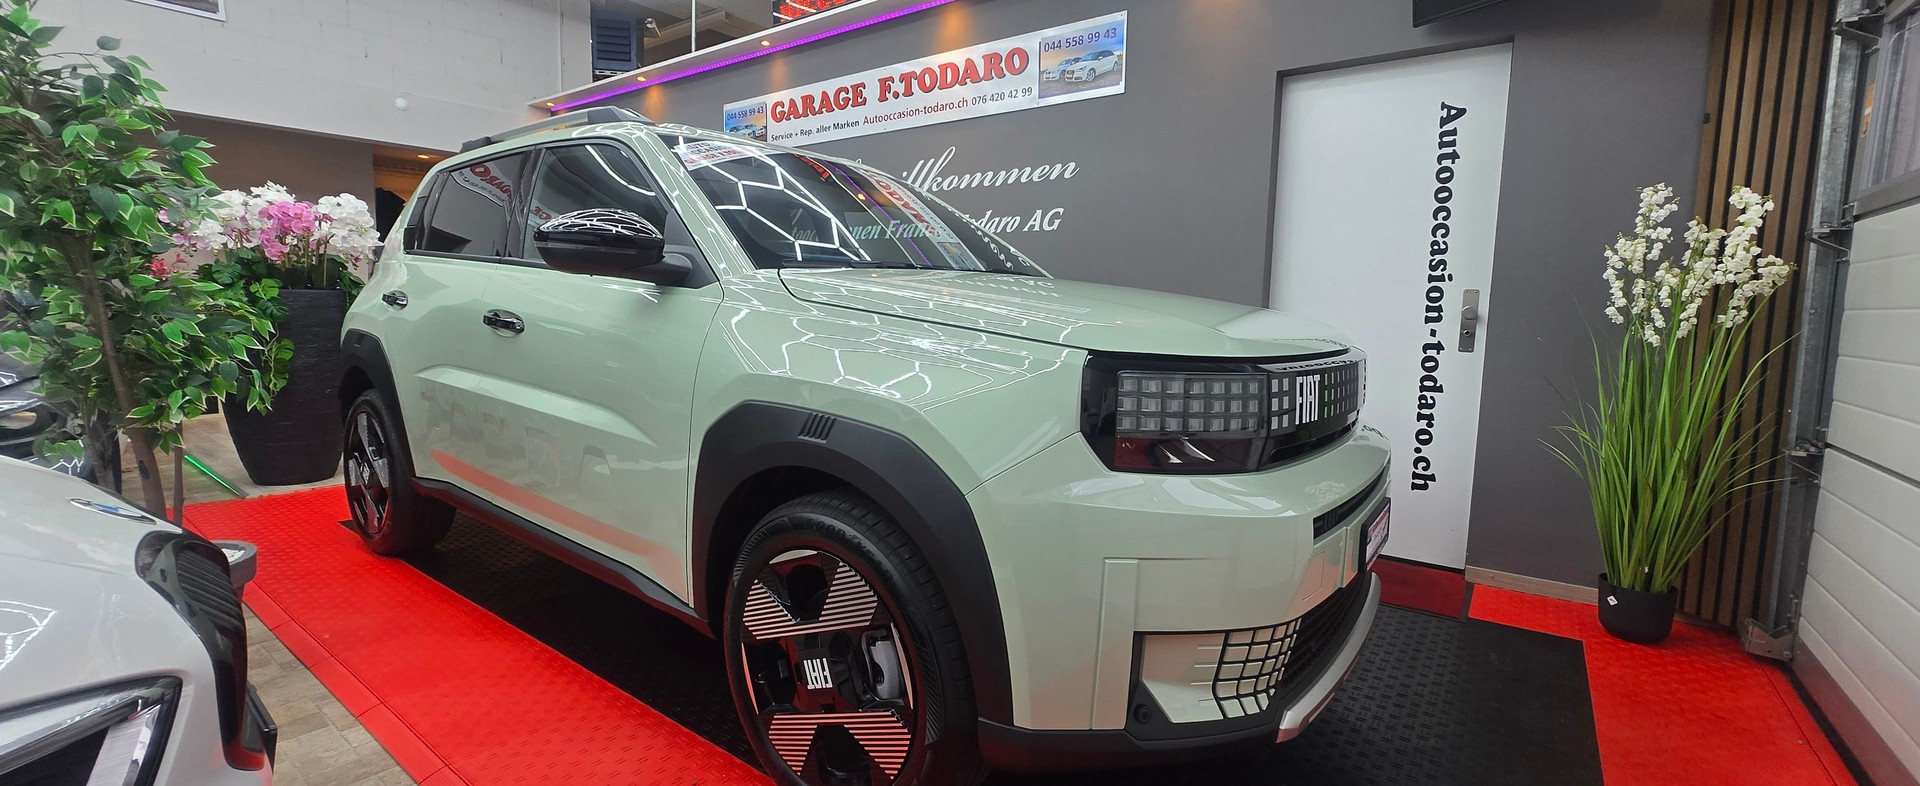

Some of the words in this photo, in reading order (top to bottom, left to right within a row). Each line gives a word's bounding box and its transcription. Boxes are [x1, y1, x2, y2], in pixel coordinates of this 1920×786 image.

[1043, 40, 1062, 53] 044
[1065, 35, 1084, 48] 558
[1087, 31, 1100, 44] 99
[1103, 27, 1117, 39] 43
[770, 81, 867, 124] GARAGE
[877, 46, 1030, 103] F.TODARO
[726, 111, 737, 121] 044
[737, 109, 748, 119] 558
[748, 107, 756, 117] 99
[756, 105, 764, 115] 43
[770, 130, 794, 142] Service
[799, 128, 815, 138] Rep.
[815, 124, 831, 134] aller
[832, 119, 860, 131] Marken
[862, 97, 968, 126] Autooccasion-todaro.ch
[971, 95, 987, 106] 076
[989, 91, 1005, 103] 420
[1007, 89, 1018, 99] 42
[1021, 86, 1033, 98] 99
[902, 146, 1081, 193] llkommen
[966, 209, 1021, 234] daro
[1022, 207, 1065, 232] AG
[1410, 101, 1468, 491] Autooccasion-todaro.ch
[1295, 374, 1321, 426] FIAT
[803, 657, 833, 690] FIAT
